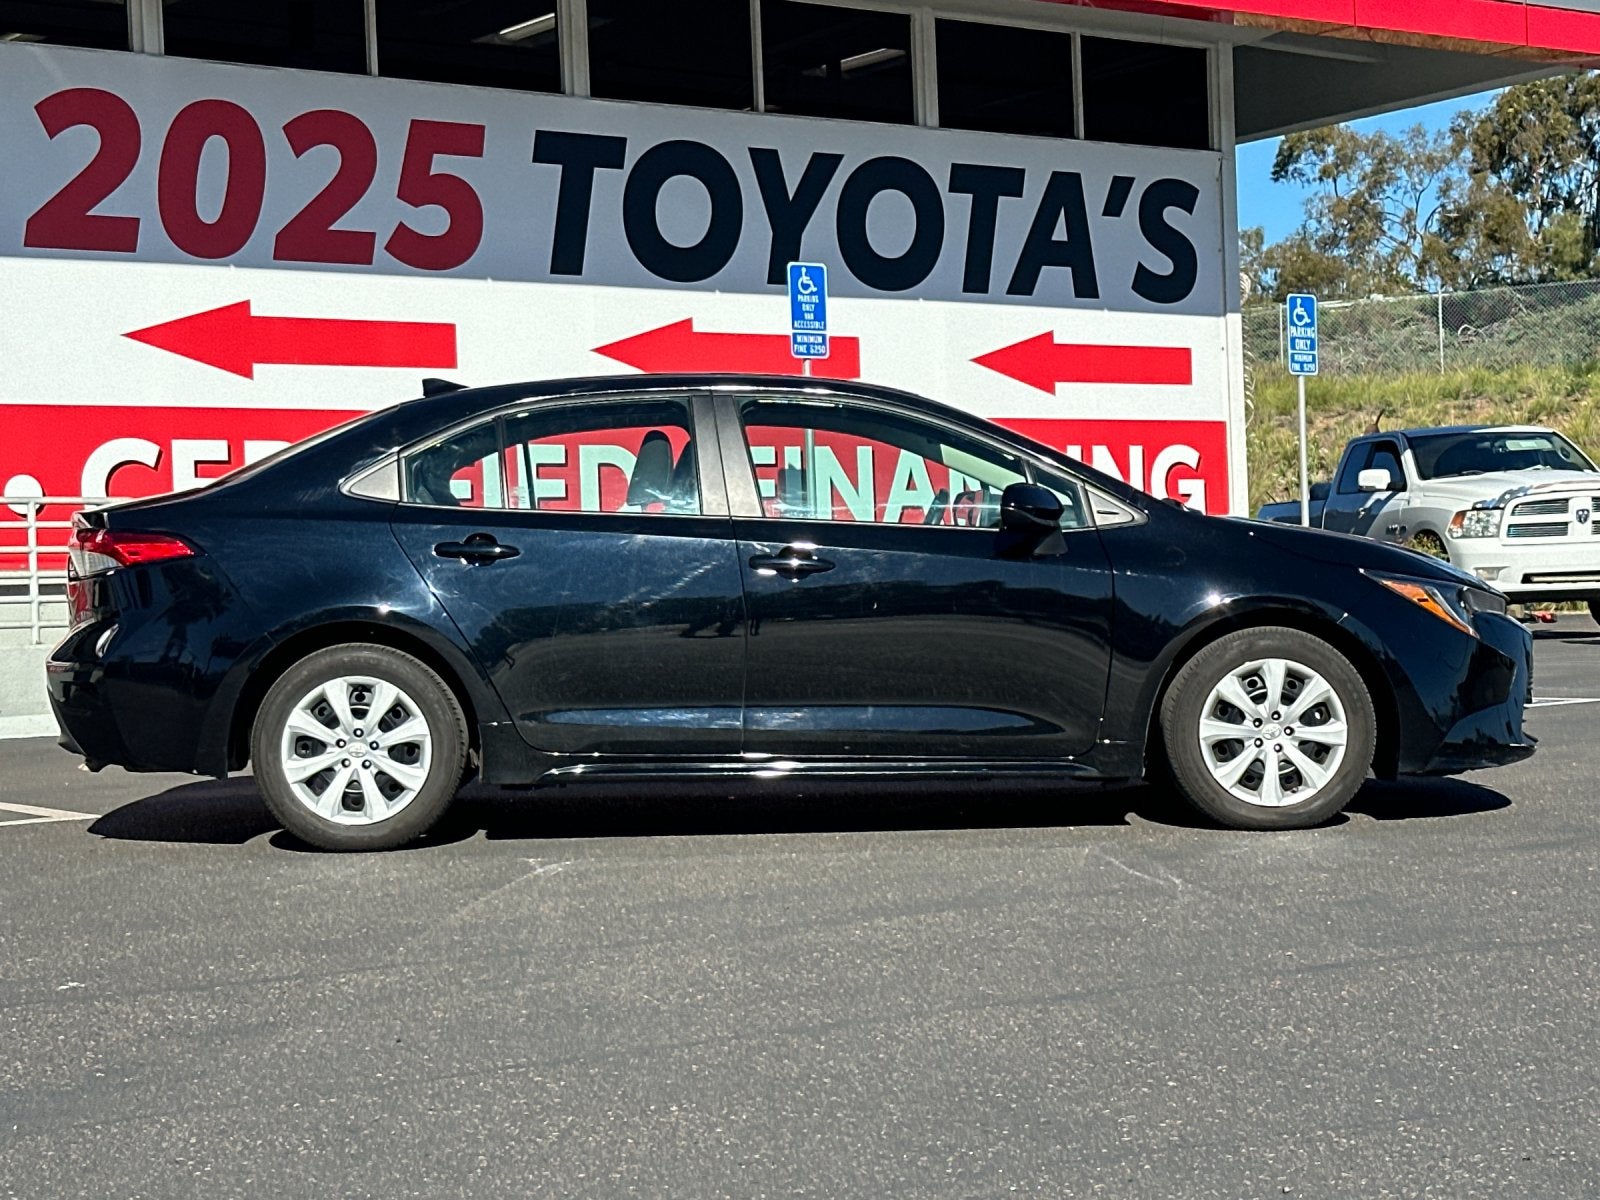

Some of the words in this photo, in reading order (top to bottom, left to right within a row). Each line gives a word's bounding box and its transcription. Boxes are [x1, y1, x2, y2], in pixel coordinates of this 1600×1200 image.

[24, 88, 484, 271] 2025
[533, 129, 1199, 304] TOYOTA'S
[797, 294, 819, 303] PARKING
[801, 303, 815, 312] ONLY
[794, 320, 825, 330] ACCESSIBLE
[1290, 325, 1315, 338] PARKING
[796, 334, 823, 344] MINIMUM
[794, 344, 807, 354] FINE
[809, 345, 826, 354] $250
[1295, 338, 1310, 351] ONLY
